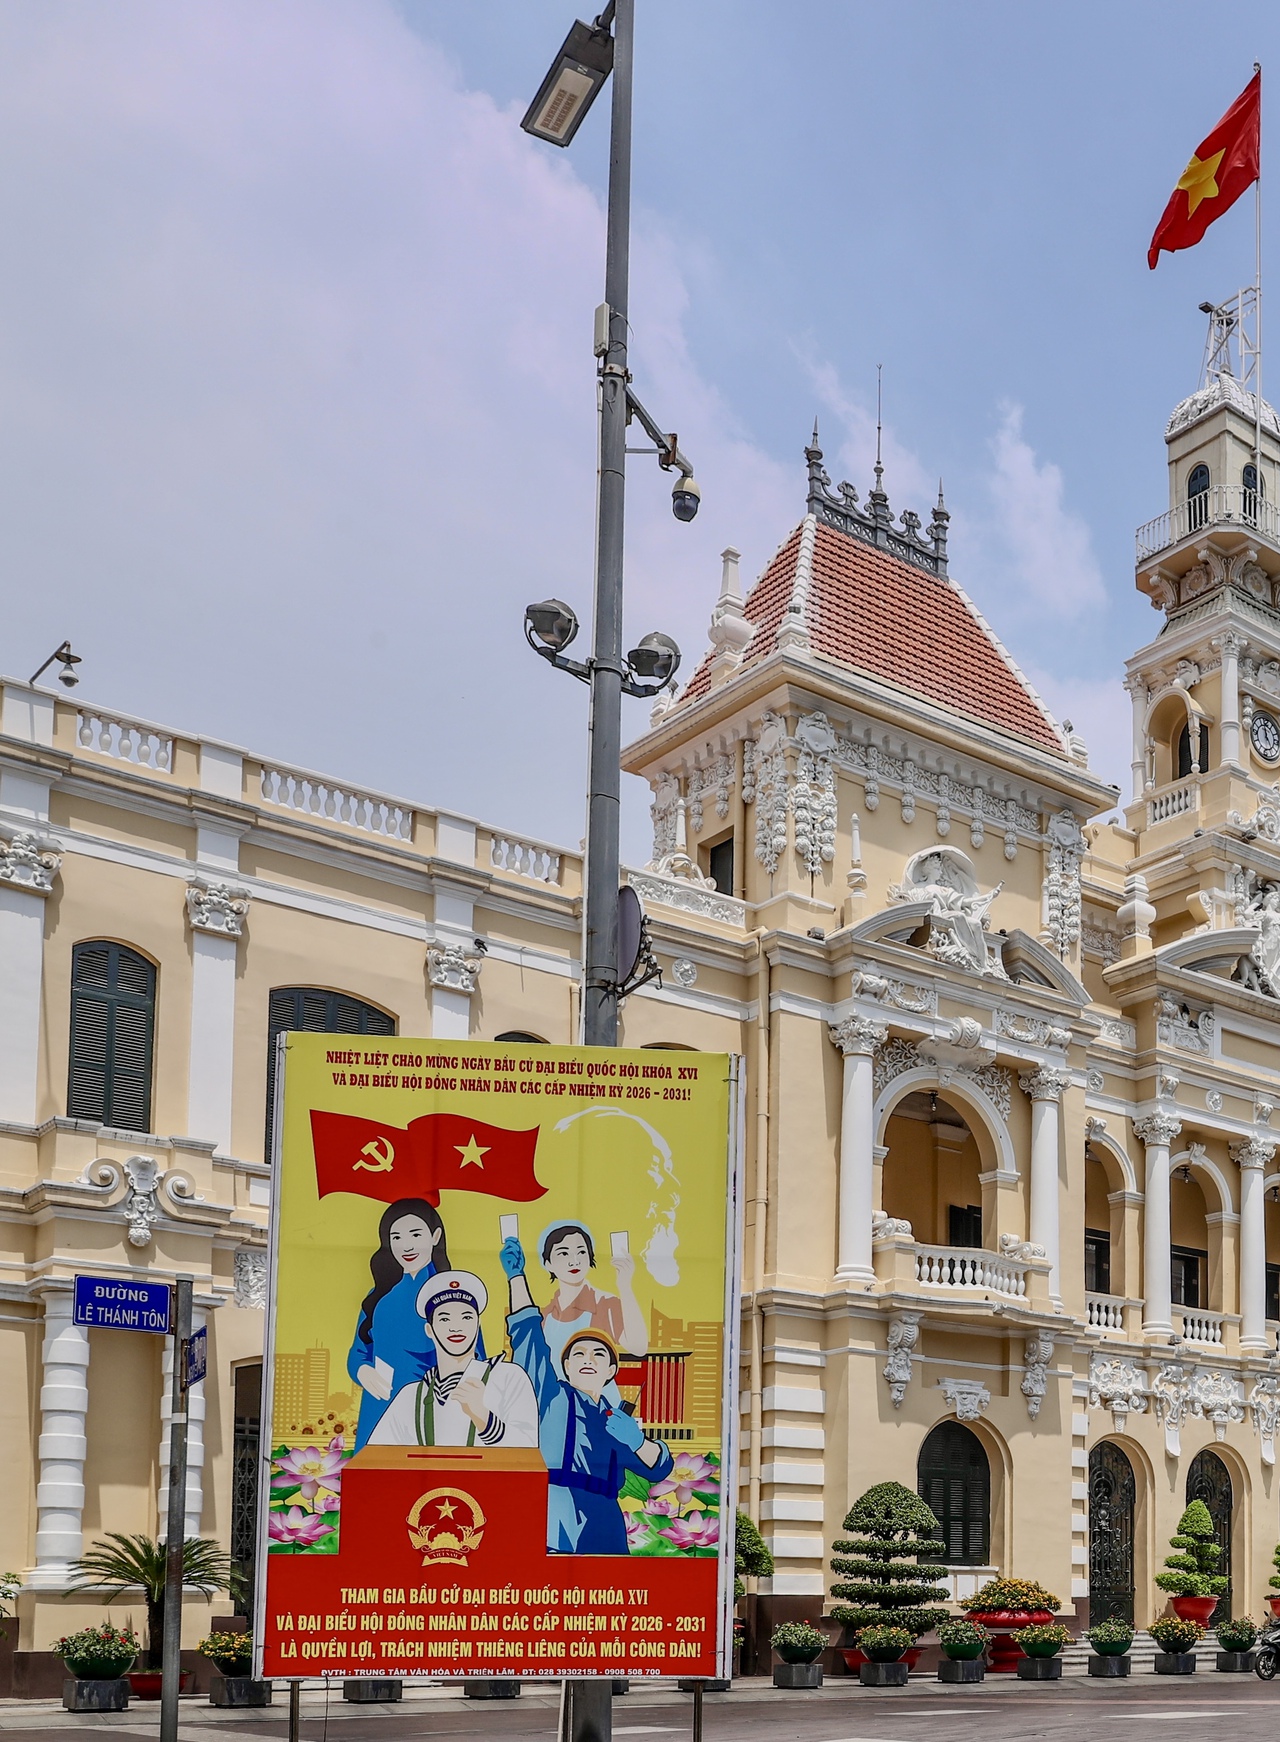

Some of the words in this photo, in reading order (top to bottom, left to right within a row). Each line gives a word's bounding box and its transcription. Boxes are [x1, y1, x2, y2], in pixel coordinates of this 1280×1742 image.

[326, 1049, 361, 1067] NHIỆT
[364, 1050, 389, 1069] LIỆT
[392, 1052, 423, 1068] CHÀO
[425, 1053, 458, 1069] MỪNG
[461, 1055, 491, 1071] NGÀY
[494, 1054, 516, 1072] BẦU
[519, 1057, 534, 1073] CỬ
[536, 1060, 555, 1076] ĐẠI
[558, 1057, 584, 1075] BIỂU
[587, 1059, 616, 1078] QUỐC
[619, 1062, 639, 1080] HỘI
[642, 1063, 672, 1079] KHÓA
[678, 1067, 698, 1080] XVI
[332, 1070, 347, 1086] VÀ
[349, 1074, 370, 1089] ĐẠI
[372, 1070, 399, 1088] BIỂU
[402, 1073, 422, 1092] HỘI
[425, 1073, 457, 1090] ĐỒNG
[460, 1077, 491, 1093] NHÂN
[494, 1078, 517, 1094] DÂN
[520, 1079, 542, 1094] CÁC
[544, 1079, 566, 1095] CẤP
[569, 1081, 606, 1100] NHIỆM
[609, 1083, 624, 1098] KỲ
[626, 1086, 651, 1099] 2026
[663, 1088, 691, 1101] 2031!
[94, 1283, 149, 1303] ĐƯỜNG
[77, 1302, 94, 1322] LÊ
[97, 1305, 139, 1326] THÁNH
[142, 1309, 165, 1328] TÔN
[340, 1588, 379, 1604] THAM
[383, 1588, 406, 1604] GIA
[409, 1583, 437, 1604] BẦU
[441, 1583, 461, 1604] CỬ
[462, 1588, 485, 1608] ĐẠI
[489, 1582, 520, 1605] BIỂU
[523, 1583, 559, 1607] QUỐC
[563, 1586, 585, 1608] HỘI
[589, 1586, 625, 1605] KHÓA
[627, 1589, 649, 1605] XVI
[276, 1611, 294, 1631] VÀ
[298, 1615, 321, 1634] ĐẠI
[325, 1608, 357, 1631] BIỂU
[360, 1611, 383, 1634] HỘI
[387, 1609, 425, 1631] ĐỒNG
[428, 1612, 467, 1631] NHÂN
[470, 1612, 499, 1631] DÂN
[502, 1612, 530, 1631] CÁC
[533, 1610, 560, 1631] CẤP
[563, 1612, 607, 1635] NHIỆM
[610, 1612, 628, 1631] KỲ
[631, 1616, 663, 1632] 2026
[675, 1616, 706, 1632] 2031
[280, 1638, 298, 1658] LÀ
[301, 1636, 347, 1660] QUYỀN
[350, 1640, 376, 1661] LỢI,
[380, 1638, 424, 1658] TRÁCH
[427, 1638, 472, 1661] NHIỆM
[476, 1638, 524, 1658] THIÊNG
[527, 1638, 566, 1658] LIÊNG
[569, 1636, 597, 1658] CỦA
[600, 1636, 626, 1658] MỖI
[629, 1638, 666, 1658] CÔNG
[669, 1639, 701, 1658] DÂN!
[452, 1667, 466, 1676] VÀ
